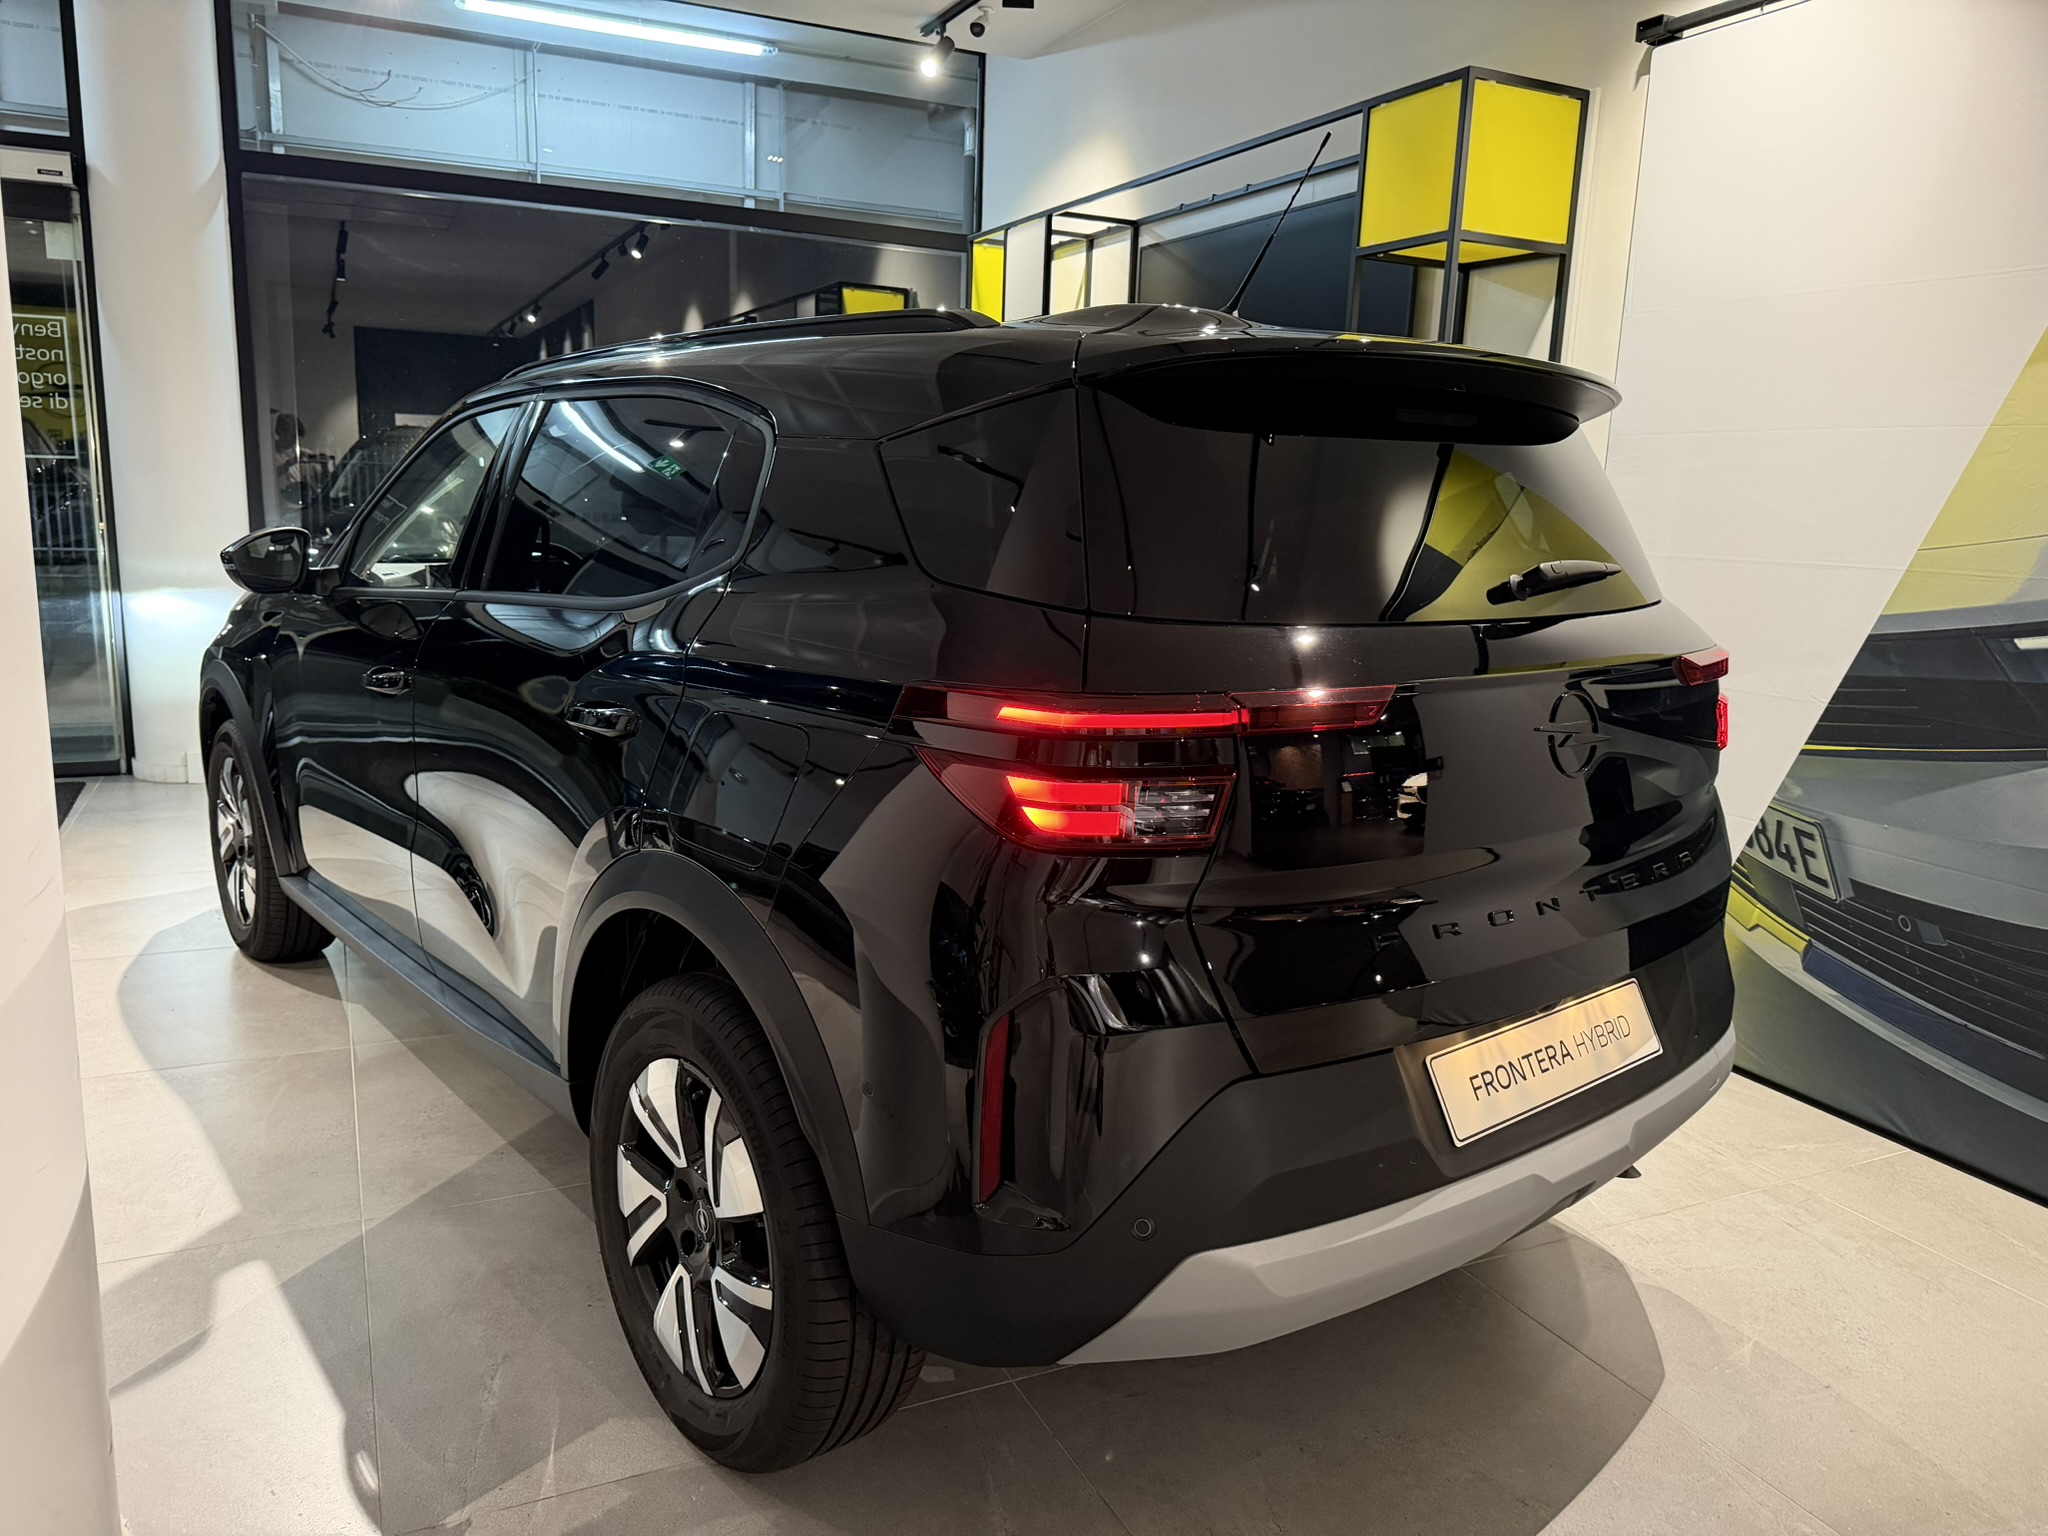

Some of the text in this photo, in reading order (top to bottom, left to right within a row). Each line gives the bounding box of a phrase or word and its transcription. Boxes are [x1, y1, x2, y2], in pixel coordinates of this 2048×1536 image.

[1746, 816, 1830, 889] 84E
[1370, 851, 1694, 951] FRONTERA
[1469, 1014, 1632, 1101] FRONTERA HYBRID
